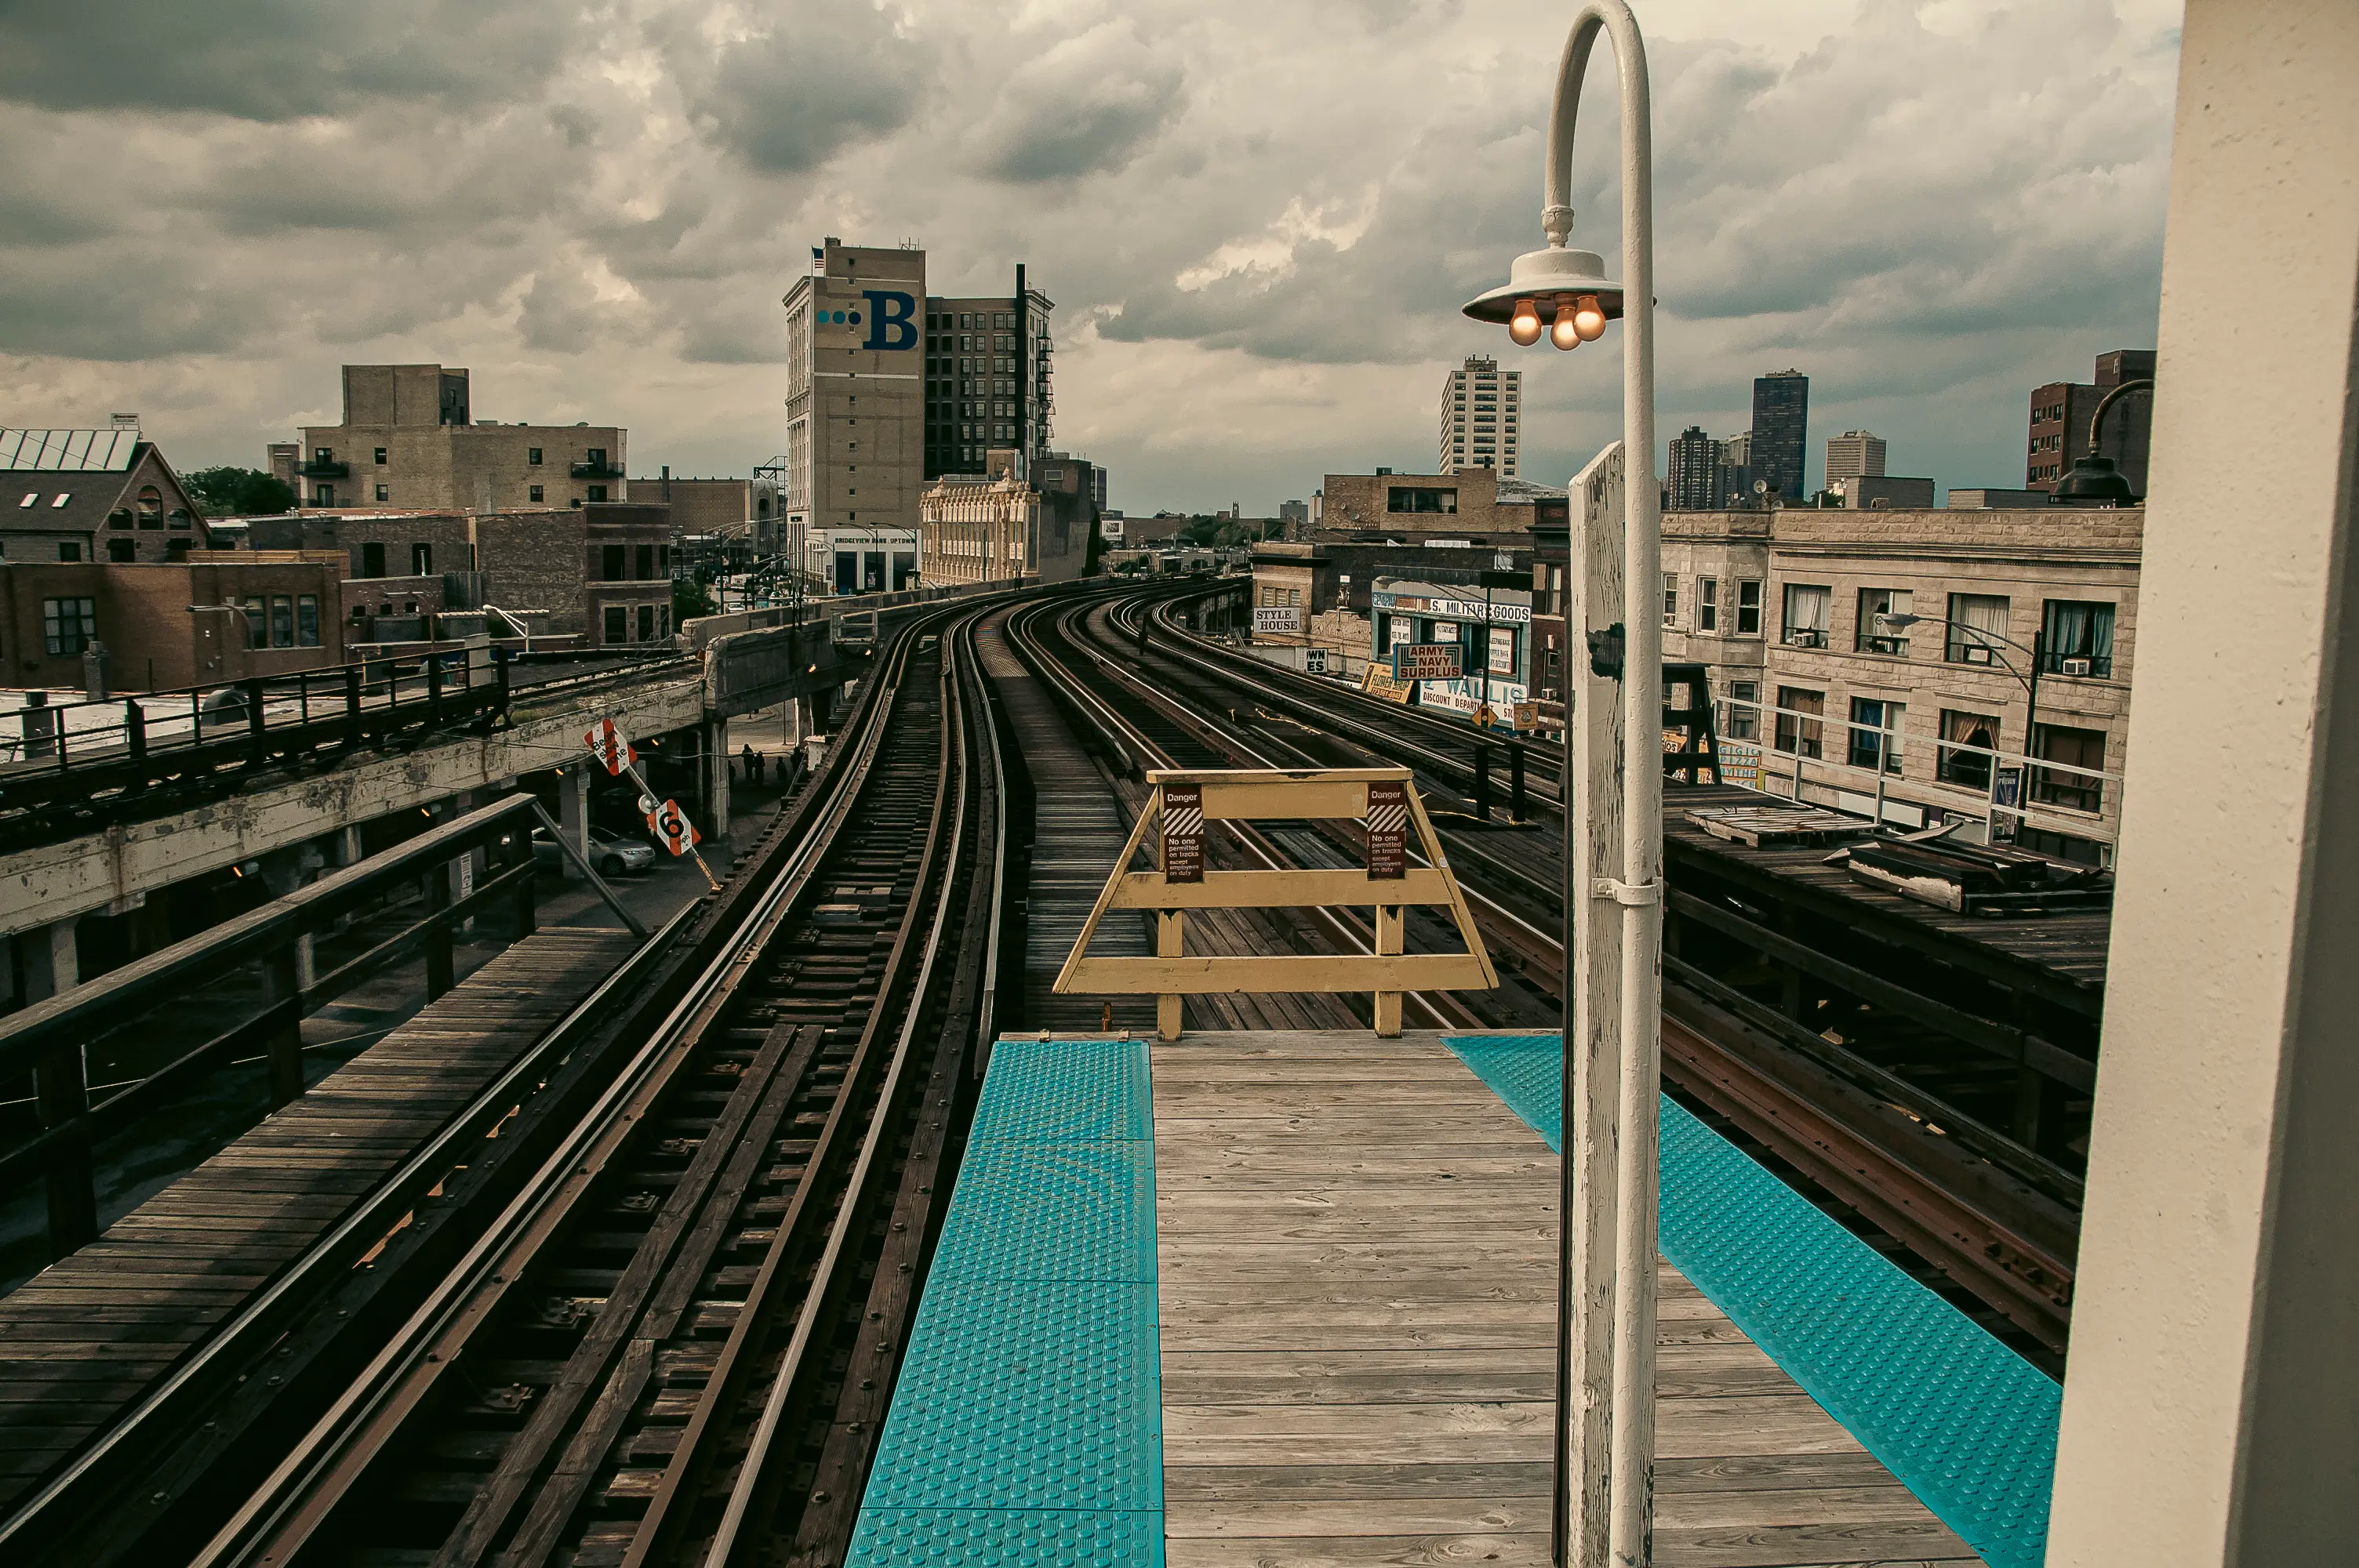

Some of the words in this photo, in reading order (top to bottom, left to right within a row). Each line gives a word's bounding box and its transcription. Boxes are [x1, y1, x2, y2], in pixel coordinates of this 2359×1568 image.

[863, 290, 918, 350] B
[1256, 610, 1292, 619] STYLE
[1446, 601, 1488, 617] MILITAR
[1493, 605, 1529, 621] GOODS
[1260, 621, 1298, 630] HOUSE
[1307, 650, 1325, 660] WN
[1410, 647, 1446, 656] ARMY
[1307, 661, 1325, 672] ES
[1419, 657, 1450, 666] NAVY
[1400, 666, 1460, 678] SURPLUS
[1446, 678, 1525, 704] WALLIS
[1423, 691, 1451, 706] DISCOUNT
[593, 730, 618, 750] Begin
[599, 741, 619, 759] slow
[606, 748, 627, 766] zone
[1720, 757, 1757, 766] PIZZA
[1736, 768, 1757, 778] THE
[1167, 793, 1197, 802] Danger
[660, 811, 684, 838] 6
